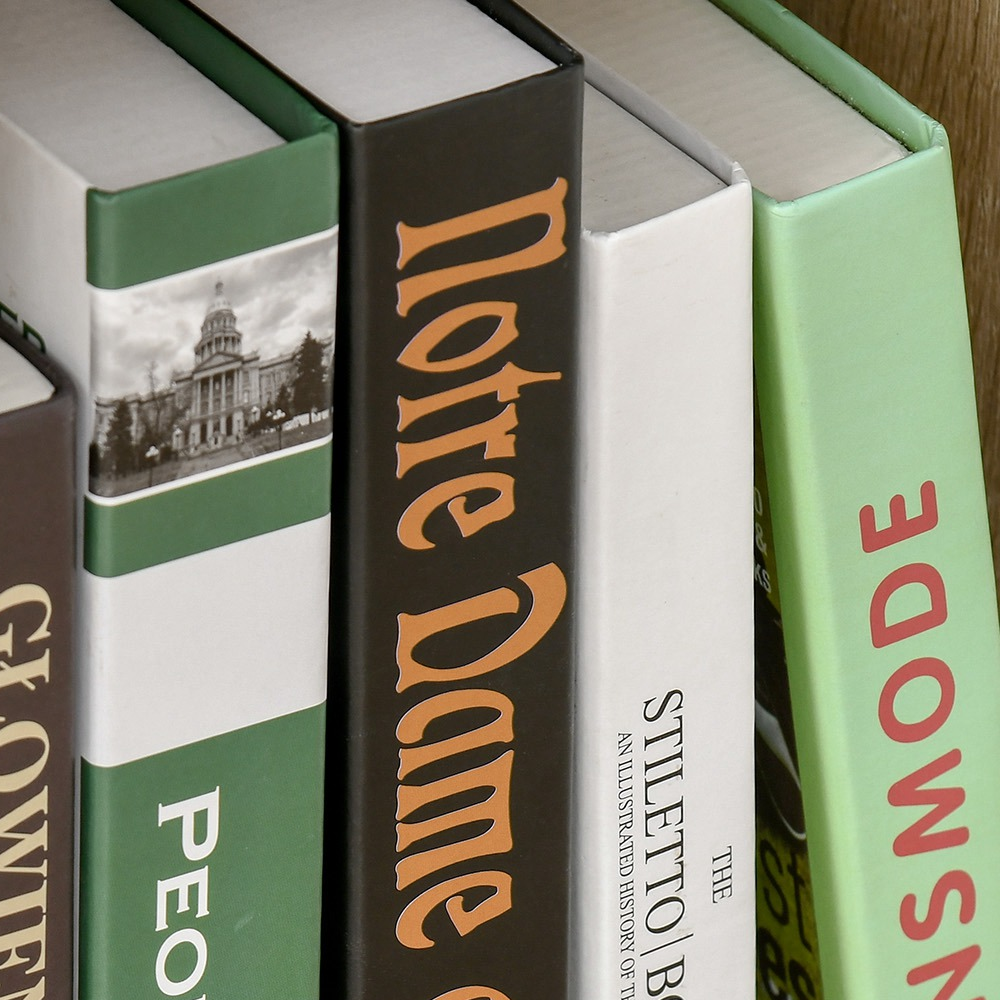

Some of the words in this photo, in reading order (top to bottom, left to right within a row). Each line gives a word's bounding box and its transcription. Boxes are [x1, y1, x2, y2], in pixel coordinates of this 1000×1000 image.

[396, 177, 568, 551] Notre
[395, 562, 567, 951] Dame
[617, 732, 634, 757] AN
[617, 758, 635, 878] ILLUSTRATED
[711, 845, 734, 904] THE
[618, 878, 636, 954] HISTORY
[619, 957, 636, 979] OF
